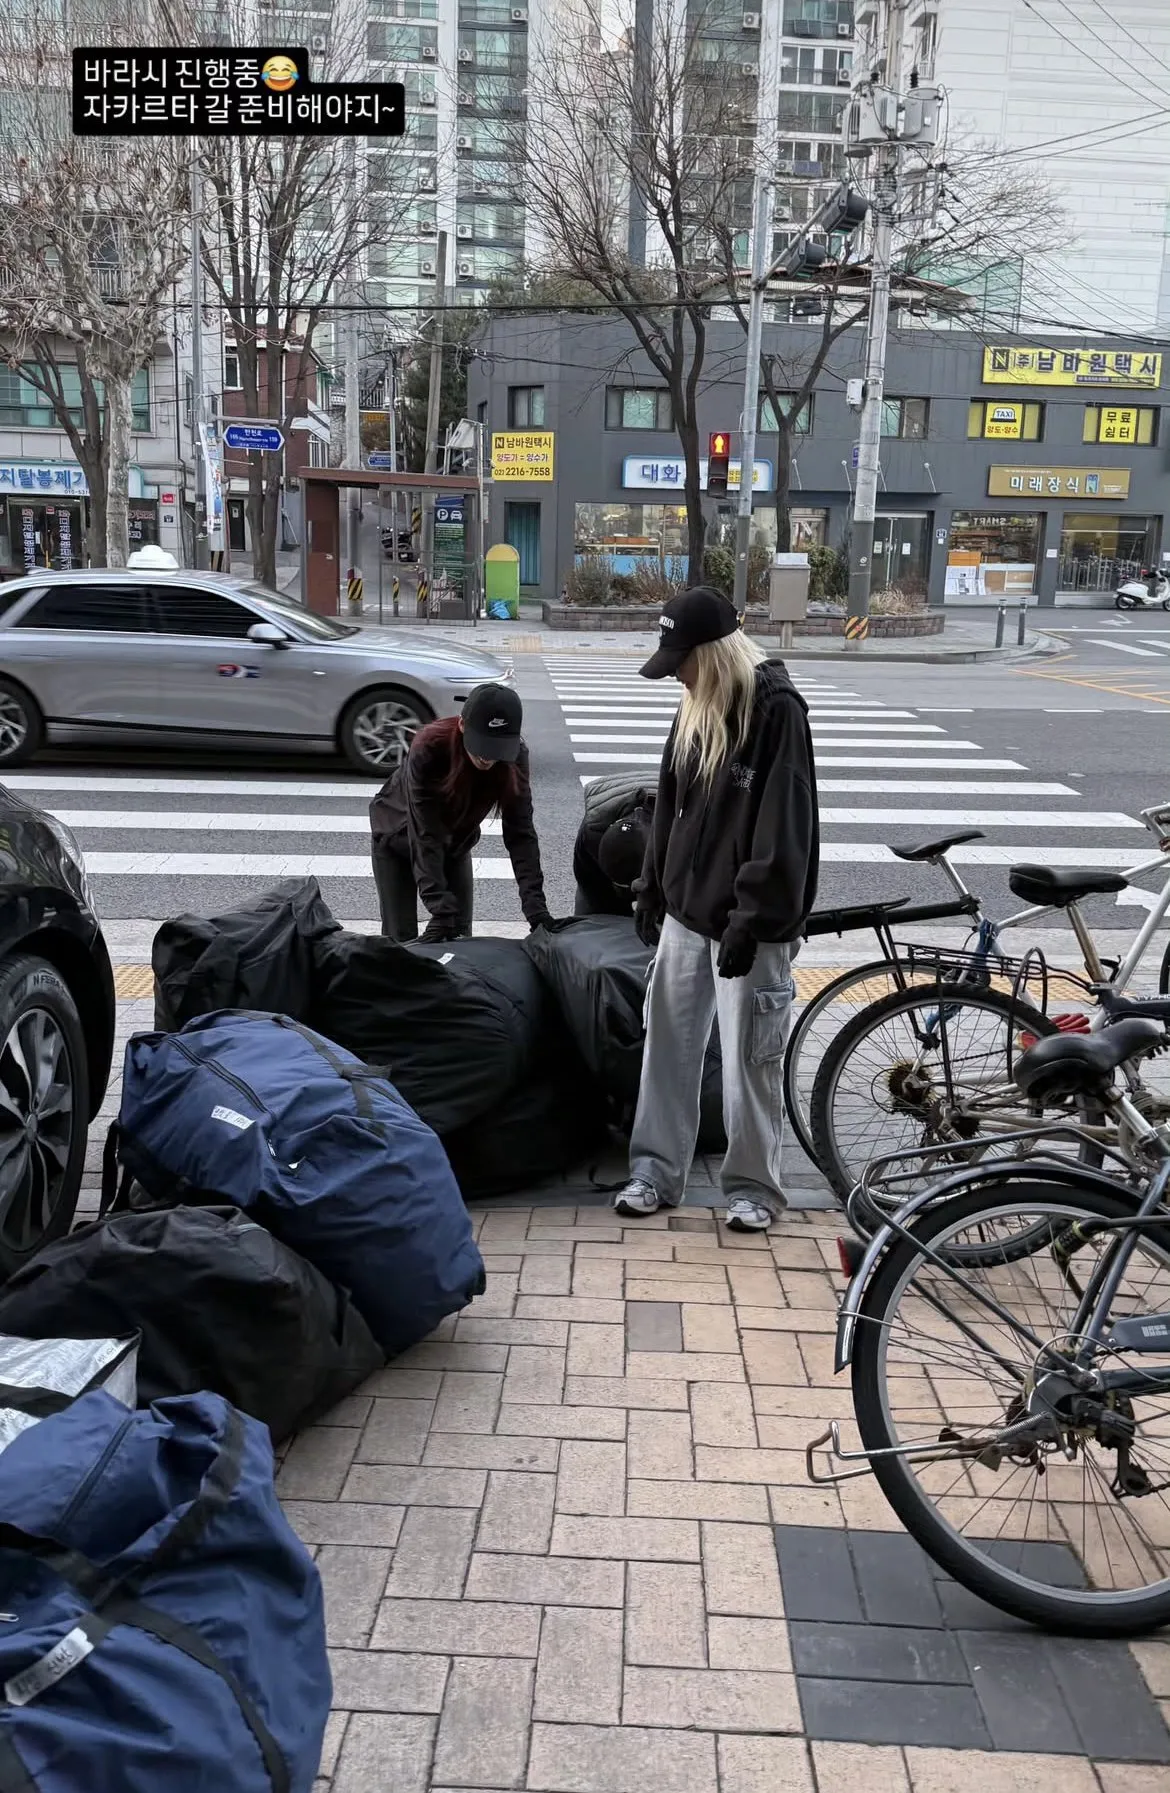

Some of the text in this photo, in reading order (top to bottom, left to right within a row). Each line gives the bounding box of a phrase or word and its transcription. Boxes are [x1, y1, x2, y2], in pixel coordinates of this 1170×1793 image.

[1037, 350, 1157, 375] 남바원택시
[996, 410, 1013, 418] TAXI
[1106, 411, 1131, 423] 무료
[1105, 427, 1130, 439] 쉼터
[506, 436, 551, 448] 남바원택시
[1010, 476, 1079, 493] 미래장식
